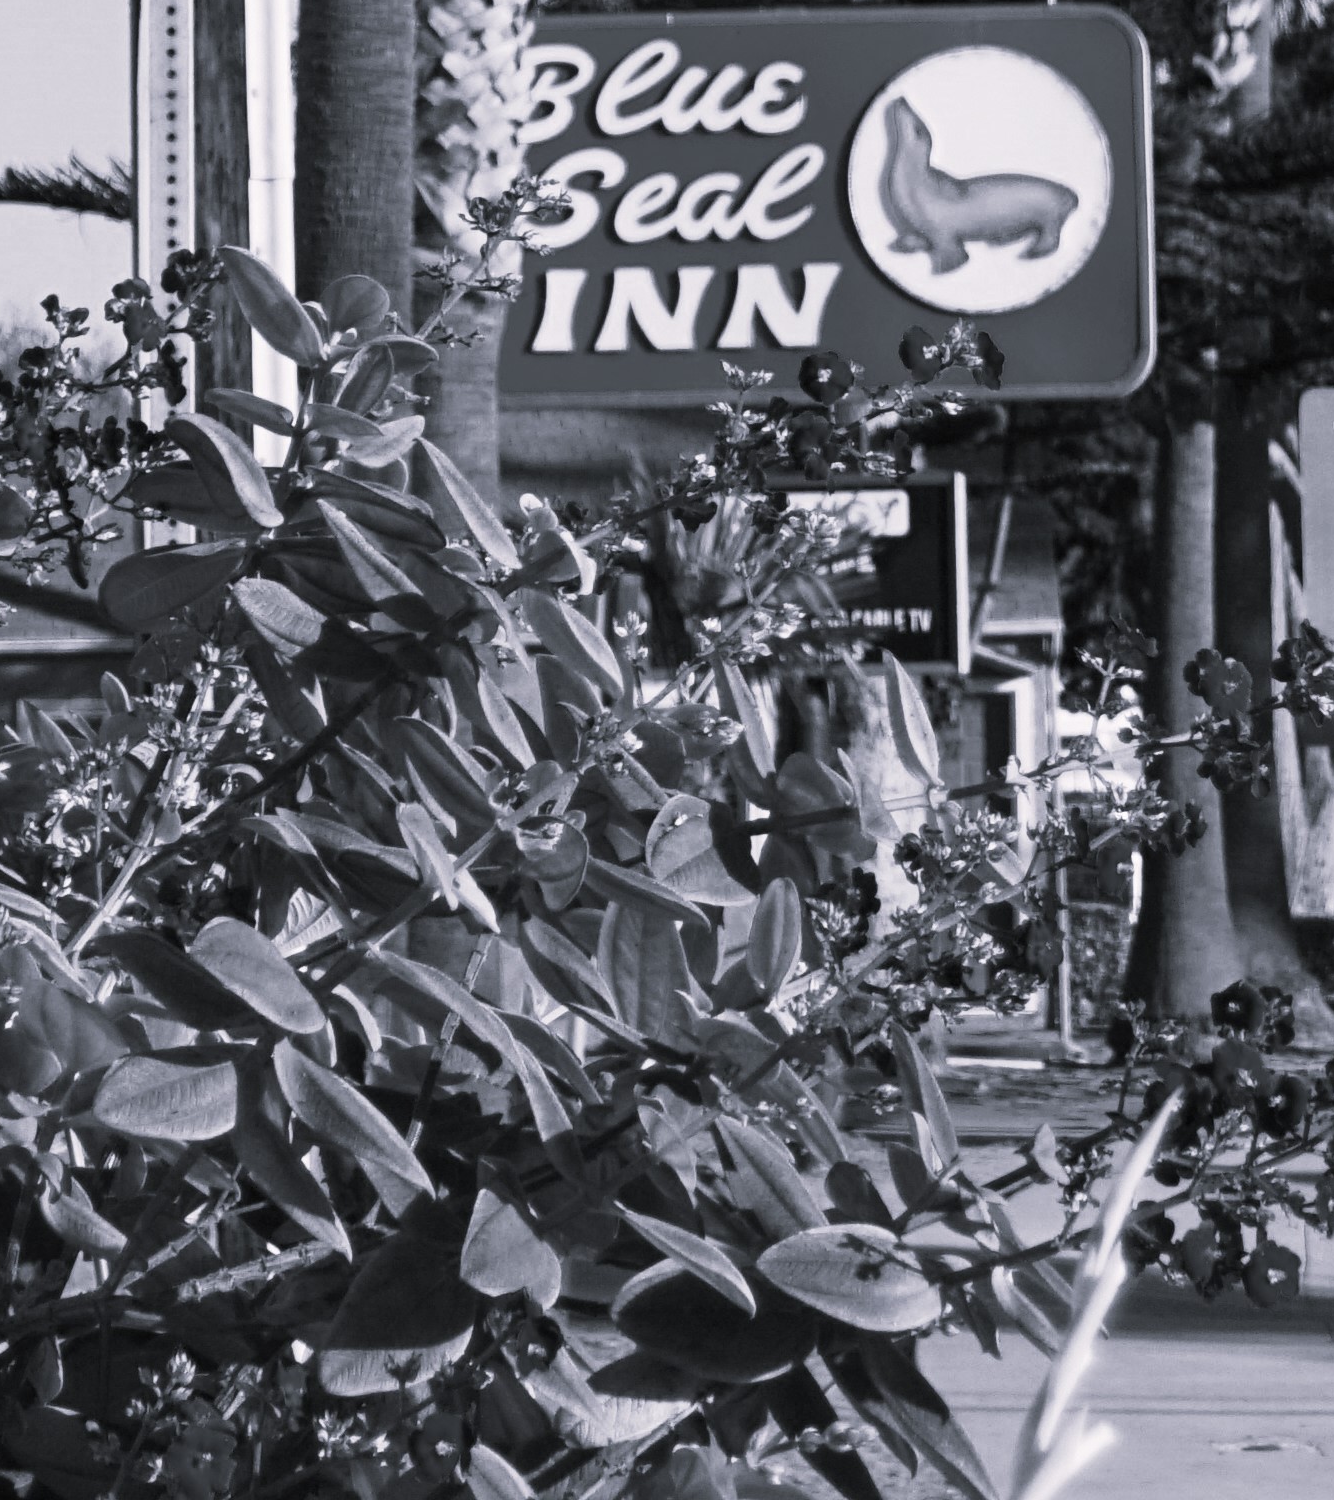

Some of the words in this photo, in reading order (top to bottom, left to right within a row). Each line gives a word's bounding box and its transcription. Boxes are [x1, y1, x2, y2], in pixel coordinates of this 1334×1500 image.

[517, 40, 806, 145] Blue
[513, 144, 827, 250] Seal
[532, 263, 841, 353] INN
